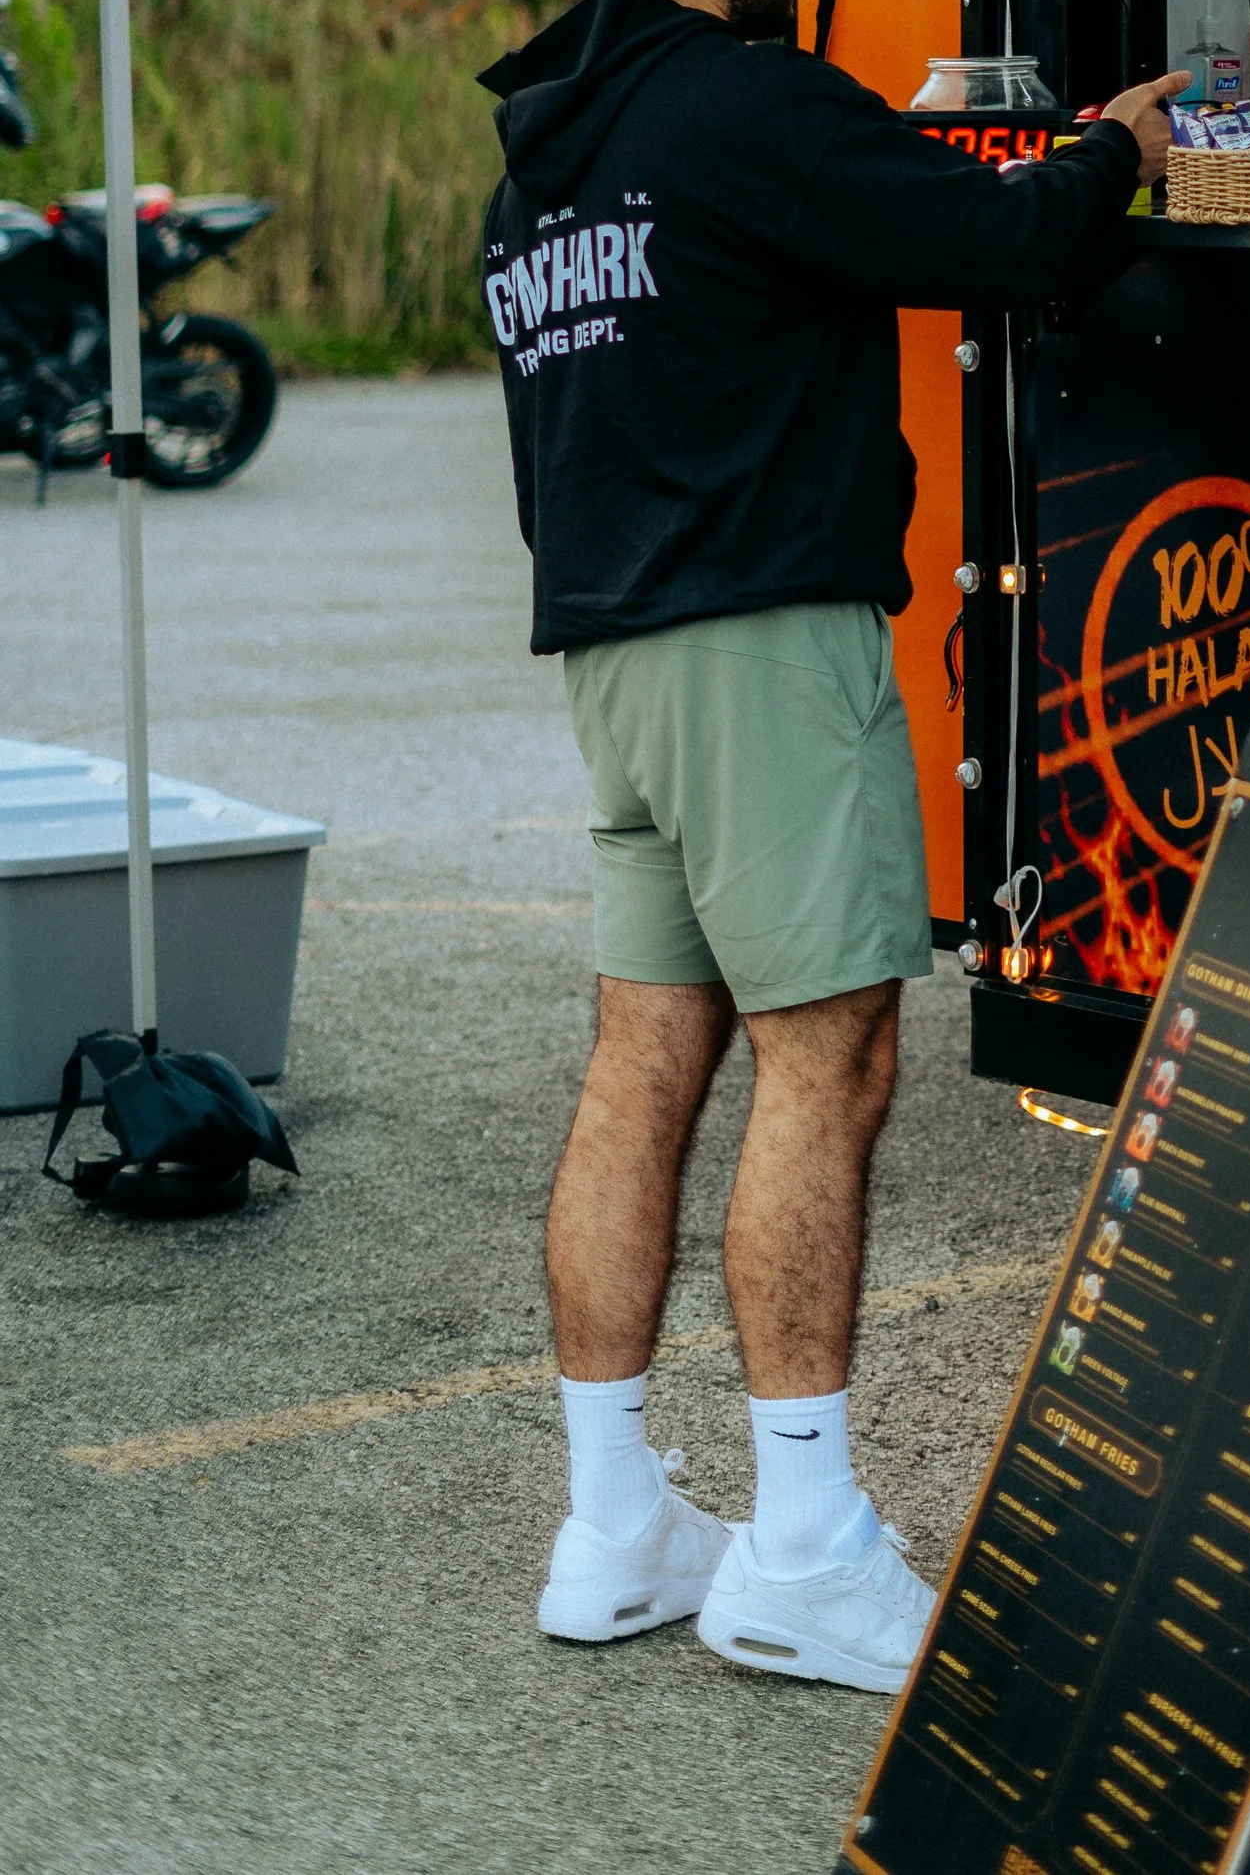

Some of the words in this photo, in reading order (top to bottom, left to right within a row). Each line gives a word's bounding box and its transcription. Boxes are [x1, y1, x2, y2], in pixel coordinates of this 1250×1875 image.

[624, 192, 651, 205] U.K.
[574, 317, 624, 350] DEPT.
[1186, 962, 1235, 994] GOTHAM
[1043, 1405, 1099, 1450] GOTHAM
[1097, 1439, 1140, 1478] FRIES
